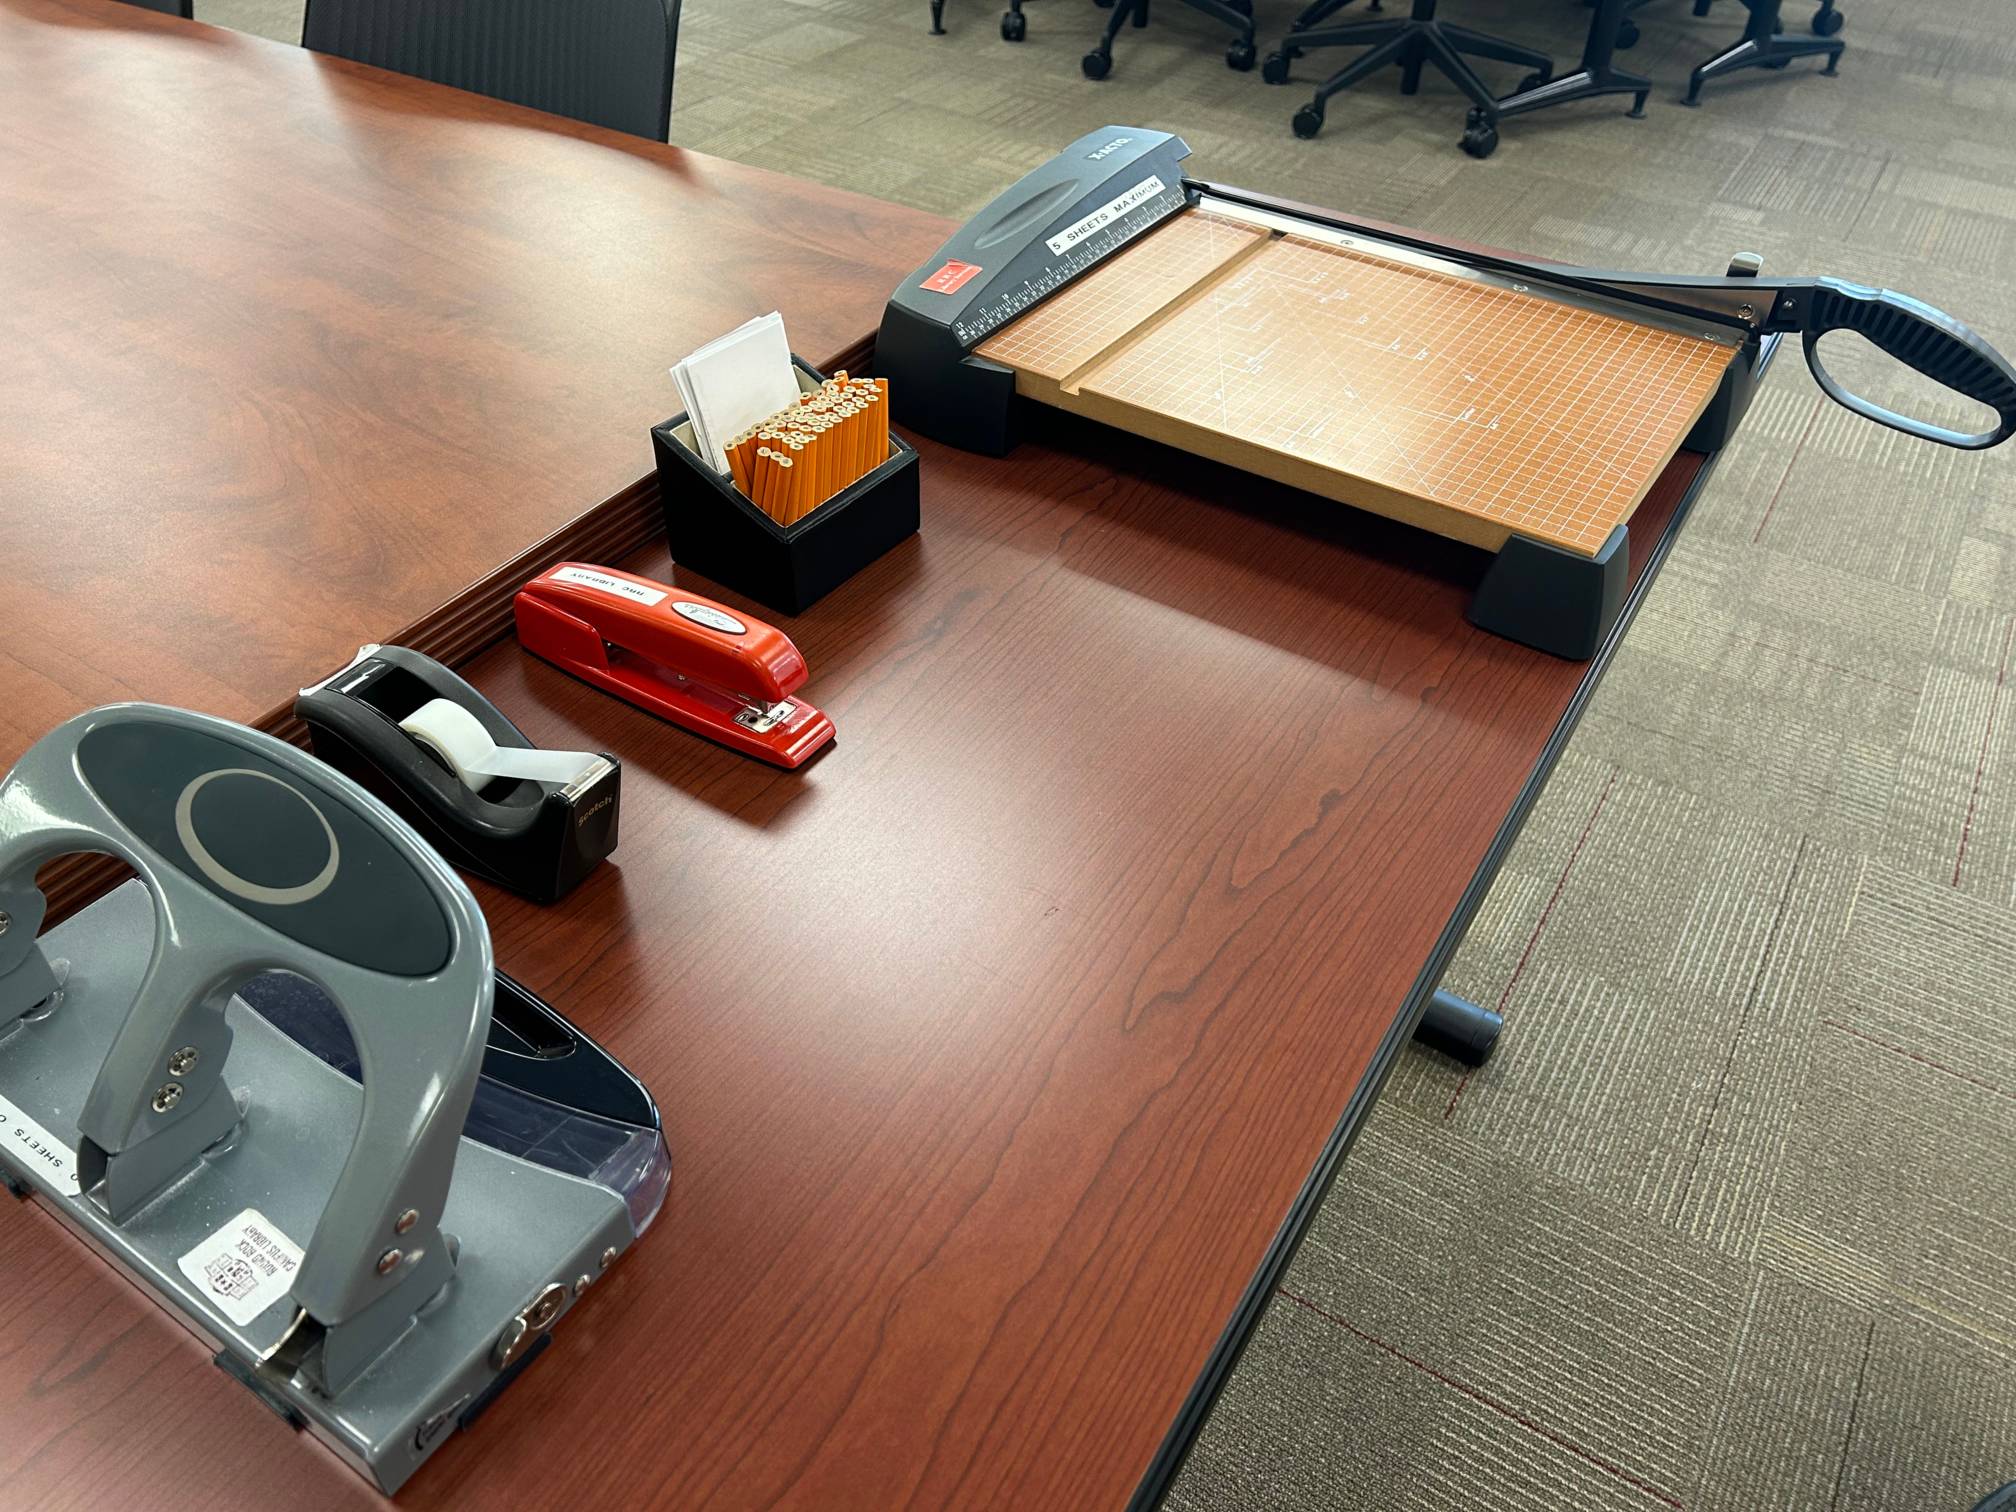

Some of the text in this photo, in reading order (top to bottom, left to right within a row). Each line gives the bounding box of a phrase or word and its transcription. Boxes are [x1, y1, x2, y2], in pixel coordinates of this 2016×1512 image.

[1052, 240, 1062, 251] 5
[1066, 213, 1109, 242] SHEETS
[1113, 181, 1160, 213] MAXIMUM
[570, 573, 616, 586] LIBRARY
[578, 796, 612, 827] Scotch
[14, 1128, 63, 1167] SHEETS
[241, 1224, 272, 1249] LIBRARY
